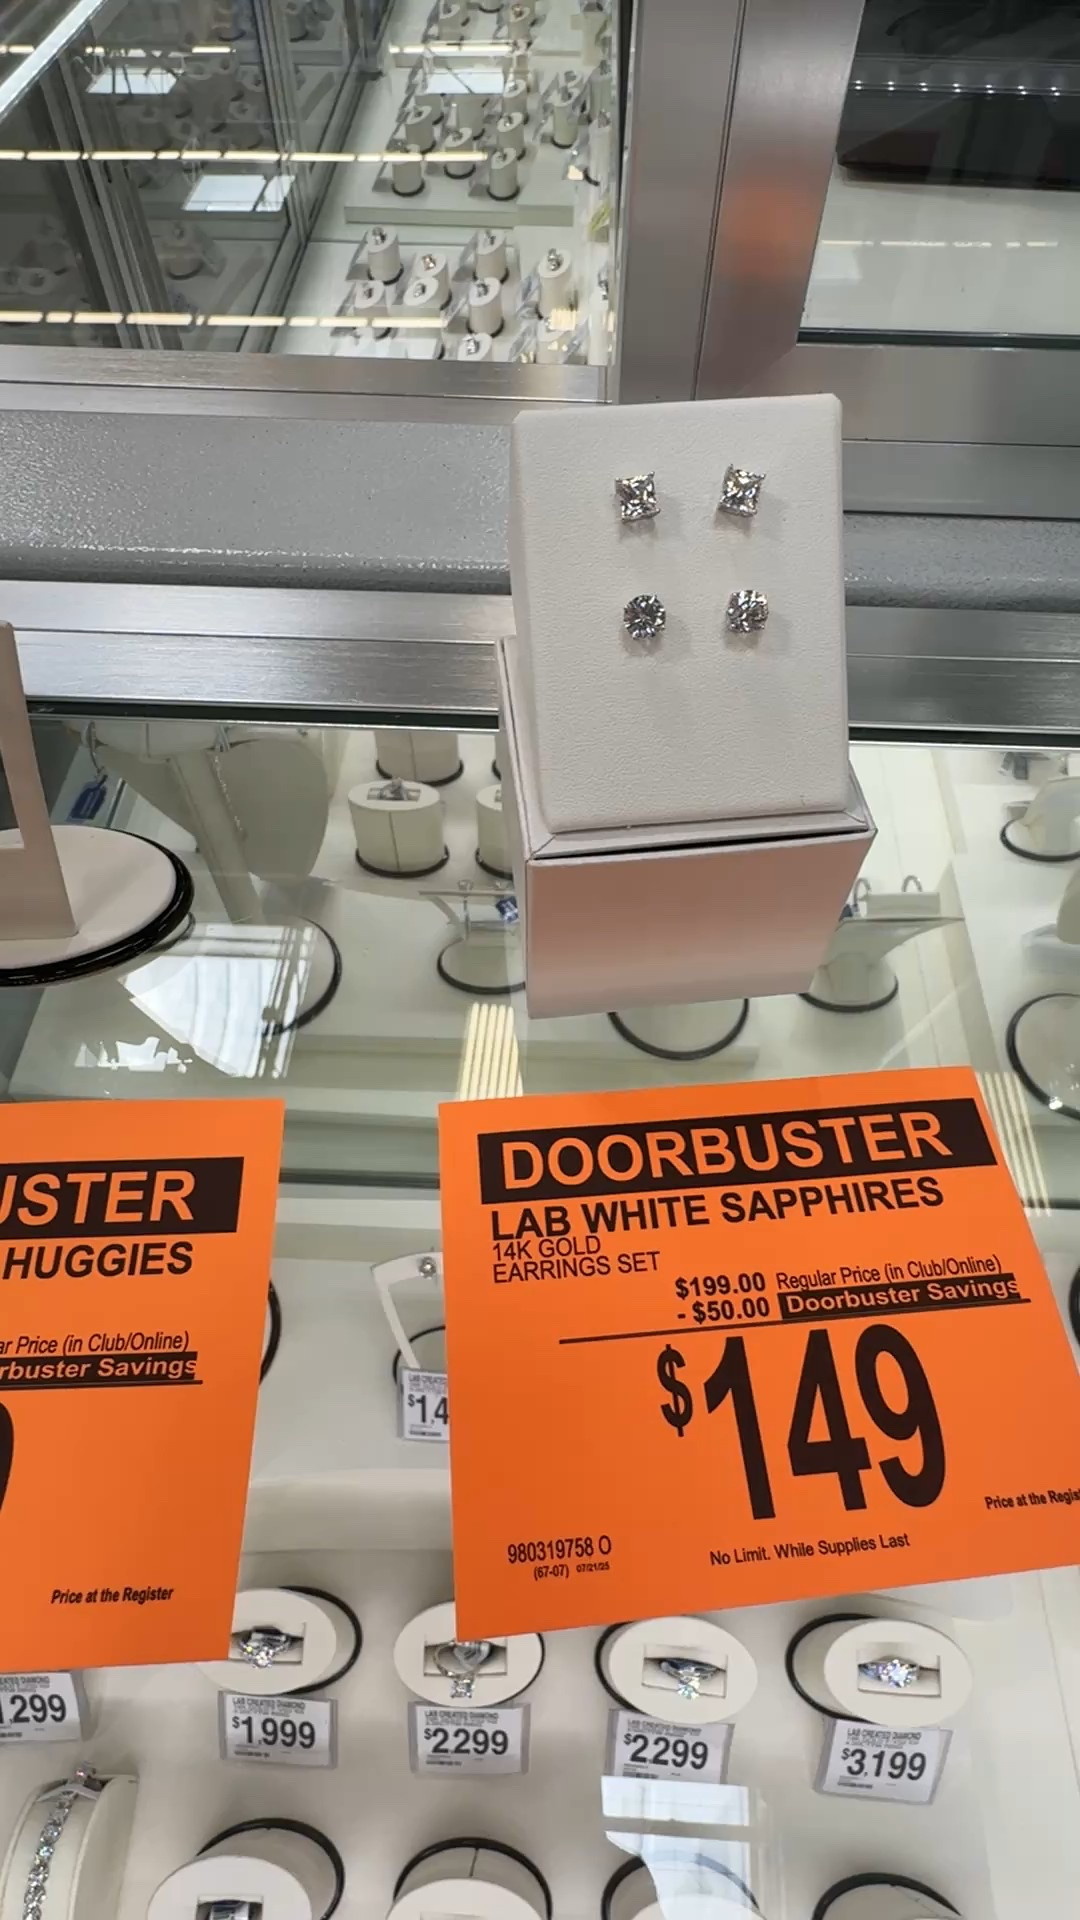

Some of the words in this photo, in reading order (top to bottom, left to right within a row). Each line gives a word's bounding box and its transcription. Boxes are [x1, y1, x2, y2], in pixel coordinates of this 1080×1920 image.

[502, 1110, 952, 1190] DOORBUSTER
[491, 1206, 572, 1241] LAB
[580, 1194, 710, 1234] WHITE
[720, 1176, 943, 1223] SAPPHIRES
[2, 1241, 193, 1280] HUGGIES
[493, 1240, 533, 1261] 14K
[538, 1235, 601, 1258] GOLD
[493, 1255, 611, 1283] EARRINGS
[617, 1251, 660, 1273] SET
[675, 1271, 766, 1300] $199.00
[776, 1268, 836, 1291] Regular
[840, 1264, 881, 1284] Price
[884, 1261, 905, 1285] (in
[907, 1253, 1003, 1279] Club/Online)
[691, 1297, 770, 1325] $50.00
[785, 1286, 921, 1314] Doorbuster
[927, 1278, 1018, 1302] Savings
[15, 1335, 58, 1354] Price
[63, 1334, 84, 1356] (in
[88, 1330, 190, 1353] Club/Online)
[98, 1356, 196, 1380] Savings
[656, 1323, 946, 1521] $149
[984, 1495, 1014, 1510] Price
[1016, 1494, 1028, 1507] at
[1028, 1491, 1047, 1505] the
[507, 1536, 594, 1564] 980319758
[710, 1551, 731, 1566] No
[734, 1545, 771, 1563] Limit.
[773, 1542, 815, 1560] While
[818, 1537, 877, 1557] Supplies
[879, 1532, 911, 1549] Last
[534, 1563, 570, 1581] (67-07)
[576, 1561, 610, 1573] 07/21/25
[50, 1588, 83, 1605] Price
[85, 1588, 98, 1603] at
[100, 1587, 120, 1602] the
[122, 1585, 175, 1605] Register
